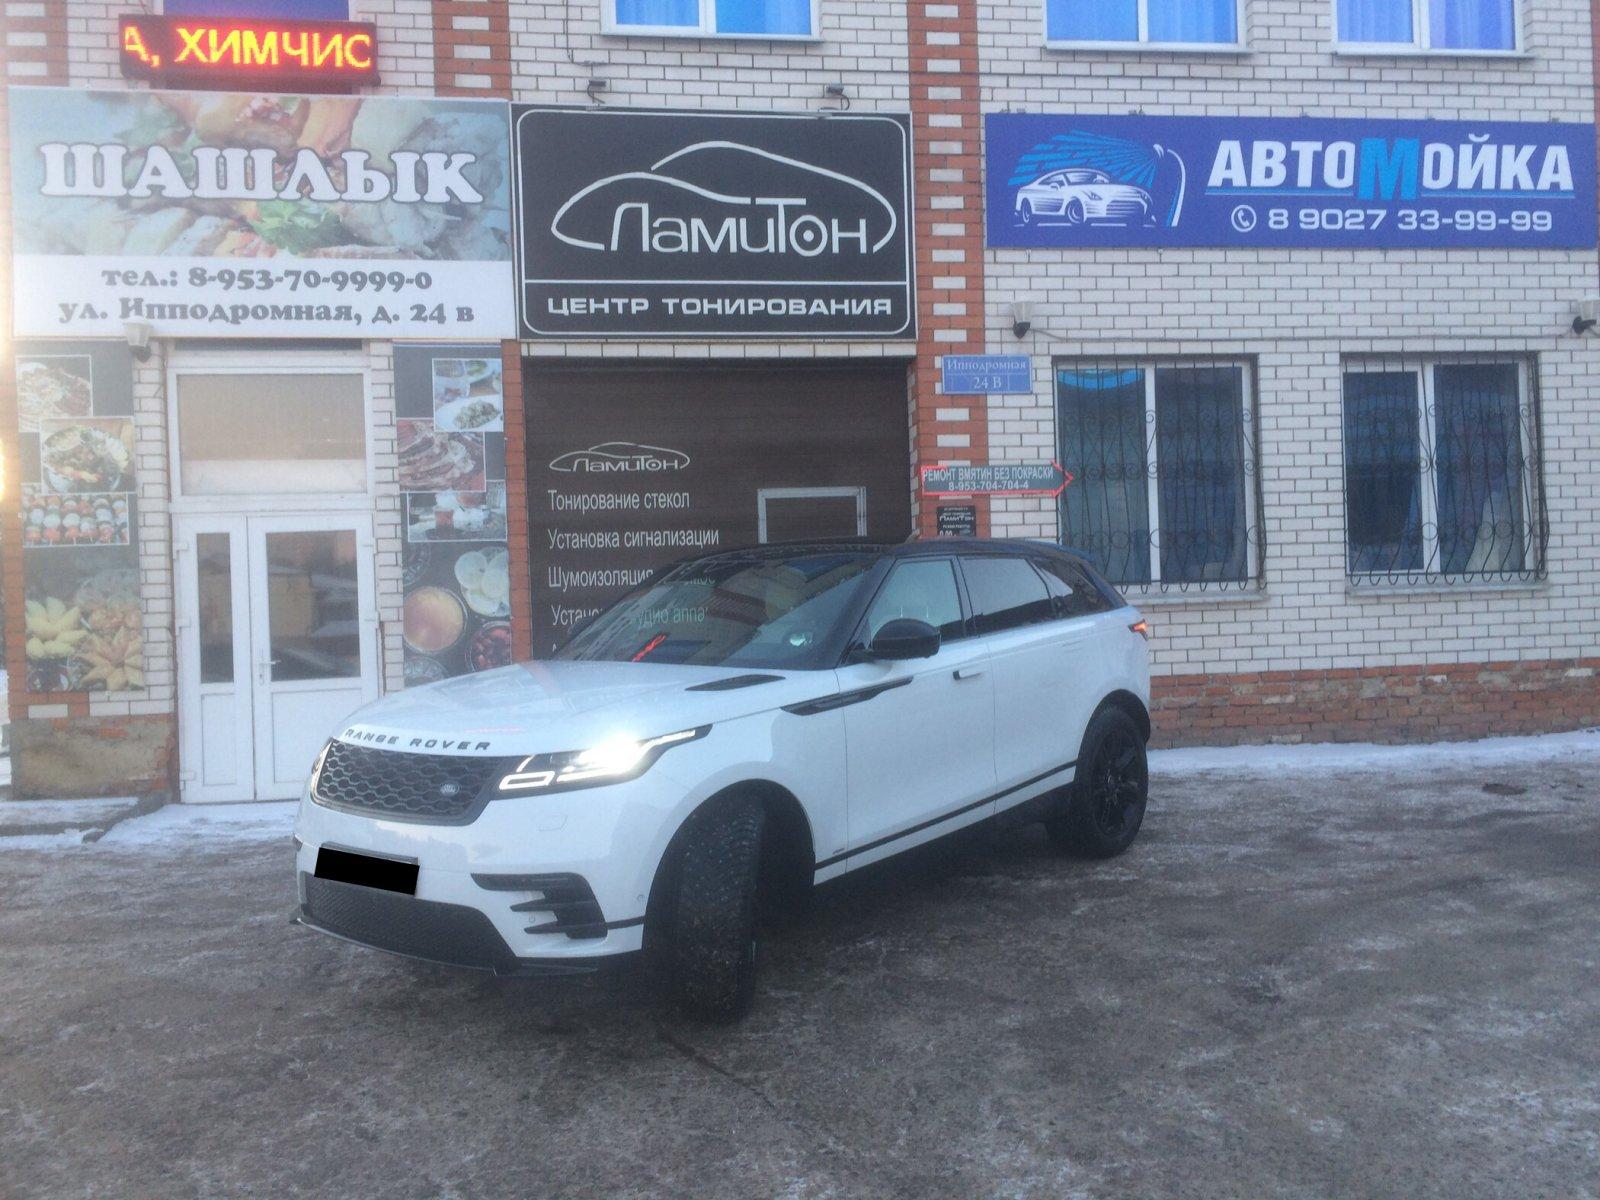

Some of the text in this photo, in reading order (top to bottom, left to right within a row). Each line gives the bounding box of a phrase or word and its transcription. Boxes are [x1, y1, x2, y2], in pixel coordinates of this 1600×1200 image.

[174, 28, 371, 69] ХИМЧИС
[39, 142, 485, 205] ШАШЛЫК
[1268, 208, 1553, 232] 8 9027 33-99-99
[101, 266, 433, 293] тел.: 8-953-70-9999-0
[58, 296, 475, 326] ул. Ипподромная, д. 24 в
[547, 297, 893, 317] ЦЕНТР ТОНИРОВАНИЯ
[947, 358, 1027, 373] Ипподромная
[974, 376, 989, 389] 24
[924, 467, 1054, 482] РЕМОНТ ВМЯТИН БЕЗ ПОКРАСКИ
[948, 480, 1029, 491] 8-953-704-704-4
[548, 489, 690, 514] Тонирование стекол
[548, 527, 719, 550] Установка сигнализации
[345, 728, 491, 751] RANGE ROVER
